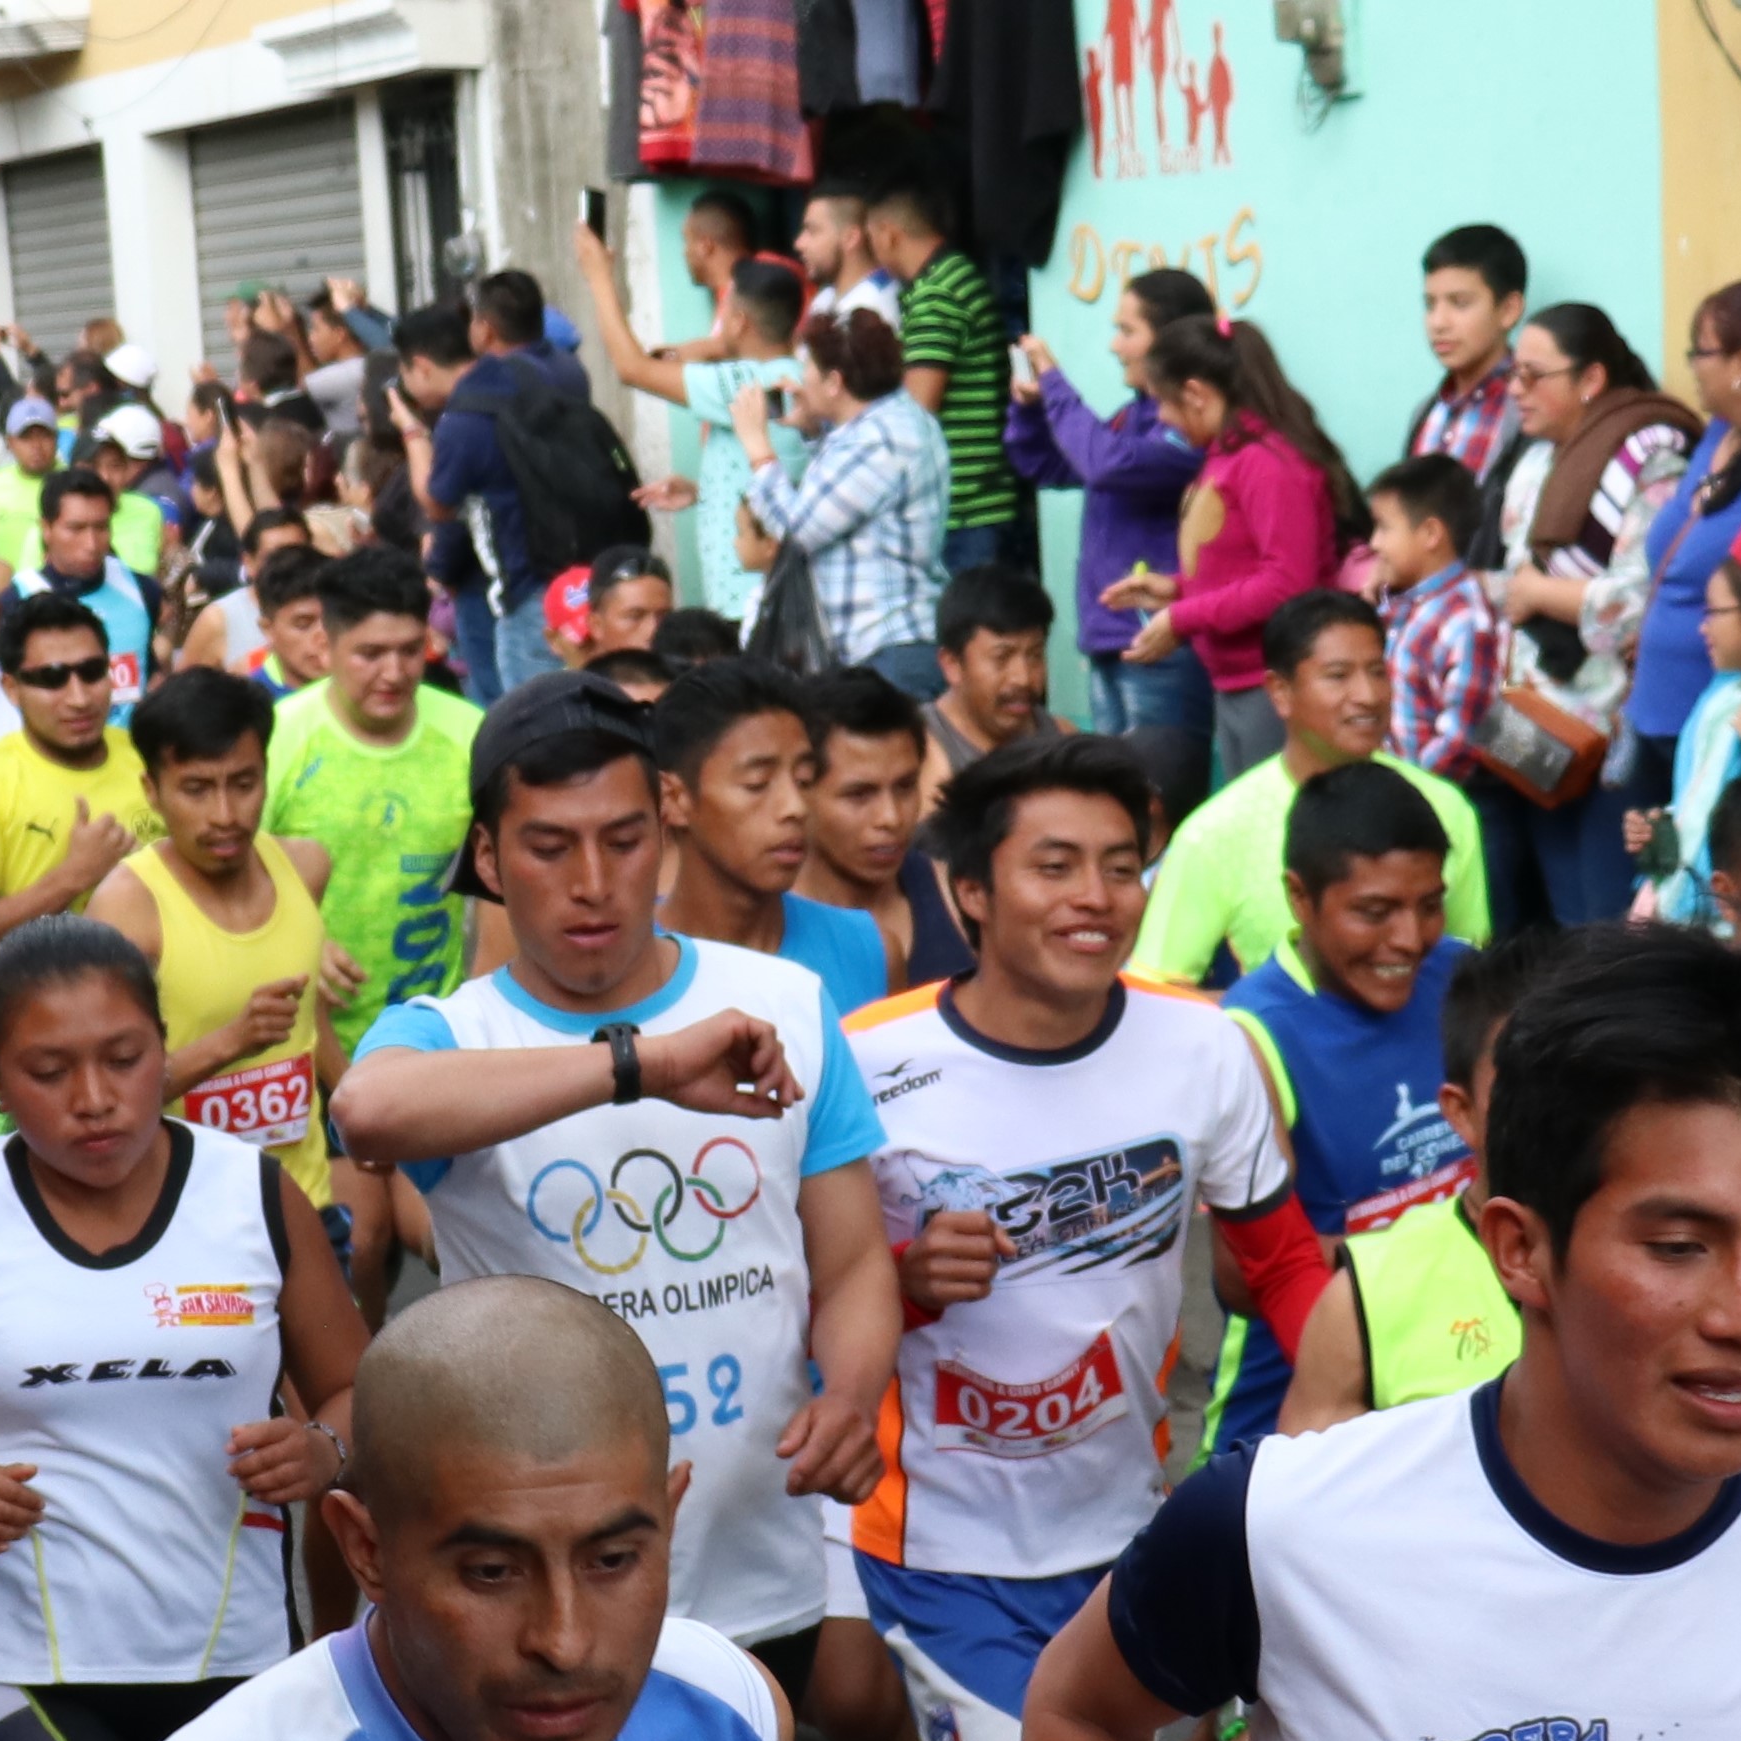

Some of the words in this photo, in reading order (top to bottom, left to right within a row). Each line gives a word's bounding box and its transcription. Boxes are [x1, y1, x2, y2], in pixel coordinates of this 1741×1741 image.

[201, 1074, 309, 1131] 0362
[873, 1069, 942, 1107] reedom
[180, 1295, 205, 1314] SAN
[663, 1263, 774, 1314] OLIMPICA
[19, 1358, 238, 1389] XELA
[958, 1365, 1105, 1437] 0204
